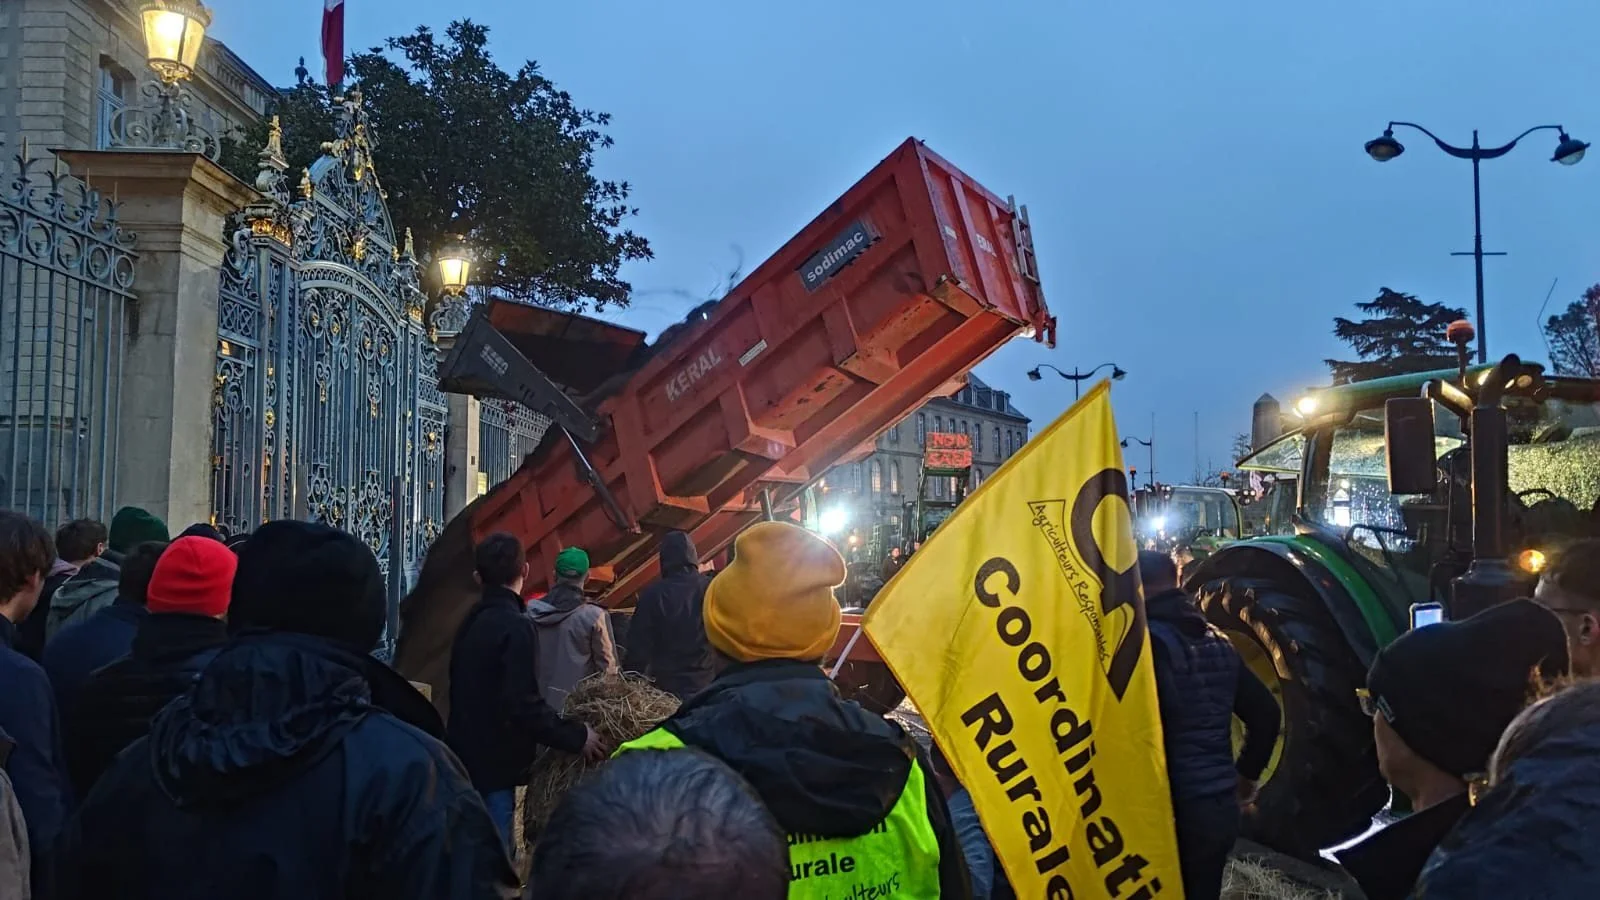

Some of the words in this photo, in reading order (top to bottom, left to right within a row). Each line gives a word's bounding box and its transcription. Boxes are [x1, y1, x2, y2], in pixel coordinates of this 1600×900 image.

[807, 232, 864, 282] sodimac
[665, 347, 721, 402] KERAL
[932, 433, 969, 448] NON
[1032, 504, 1079, 581] Agriculteurs
[1074, 581, 1110, 662] Responsables
[960, 692, 1074, 900] Rurale
[790, 852, 856, 881] urale
